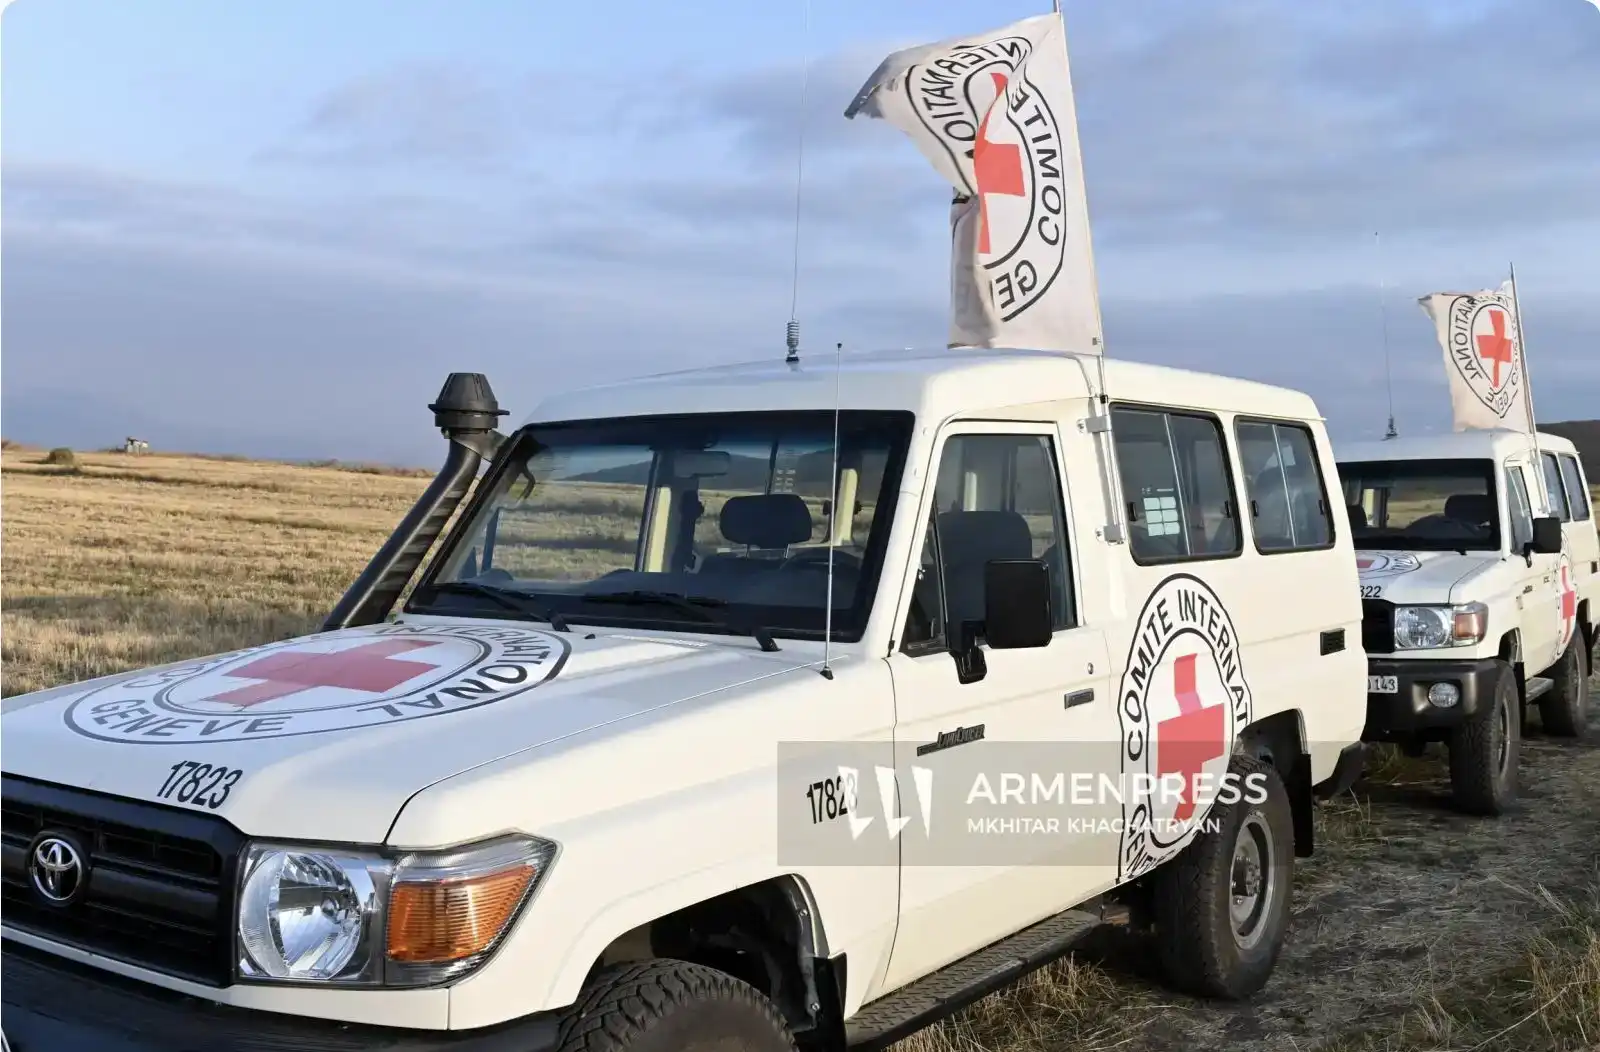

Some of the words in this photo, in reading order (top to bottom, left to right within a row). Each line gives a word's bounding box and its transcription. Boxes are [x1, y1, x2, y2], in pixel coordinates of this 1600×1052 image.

[356, 626, 551, 718] INTERNATIONAL
[1124, 598, 1174, 762] COMITE
[91, 699, 293, 737] GENEVE
[156, 760, 243, 809] 17823
